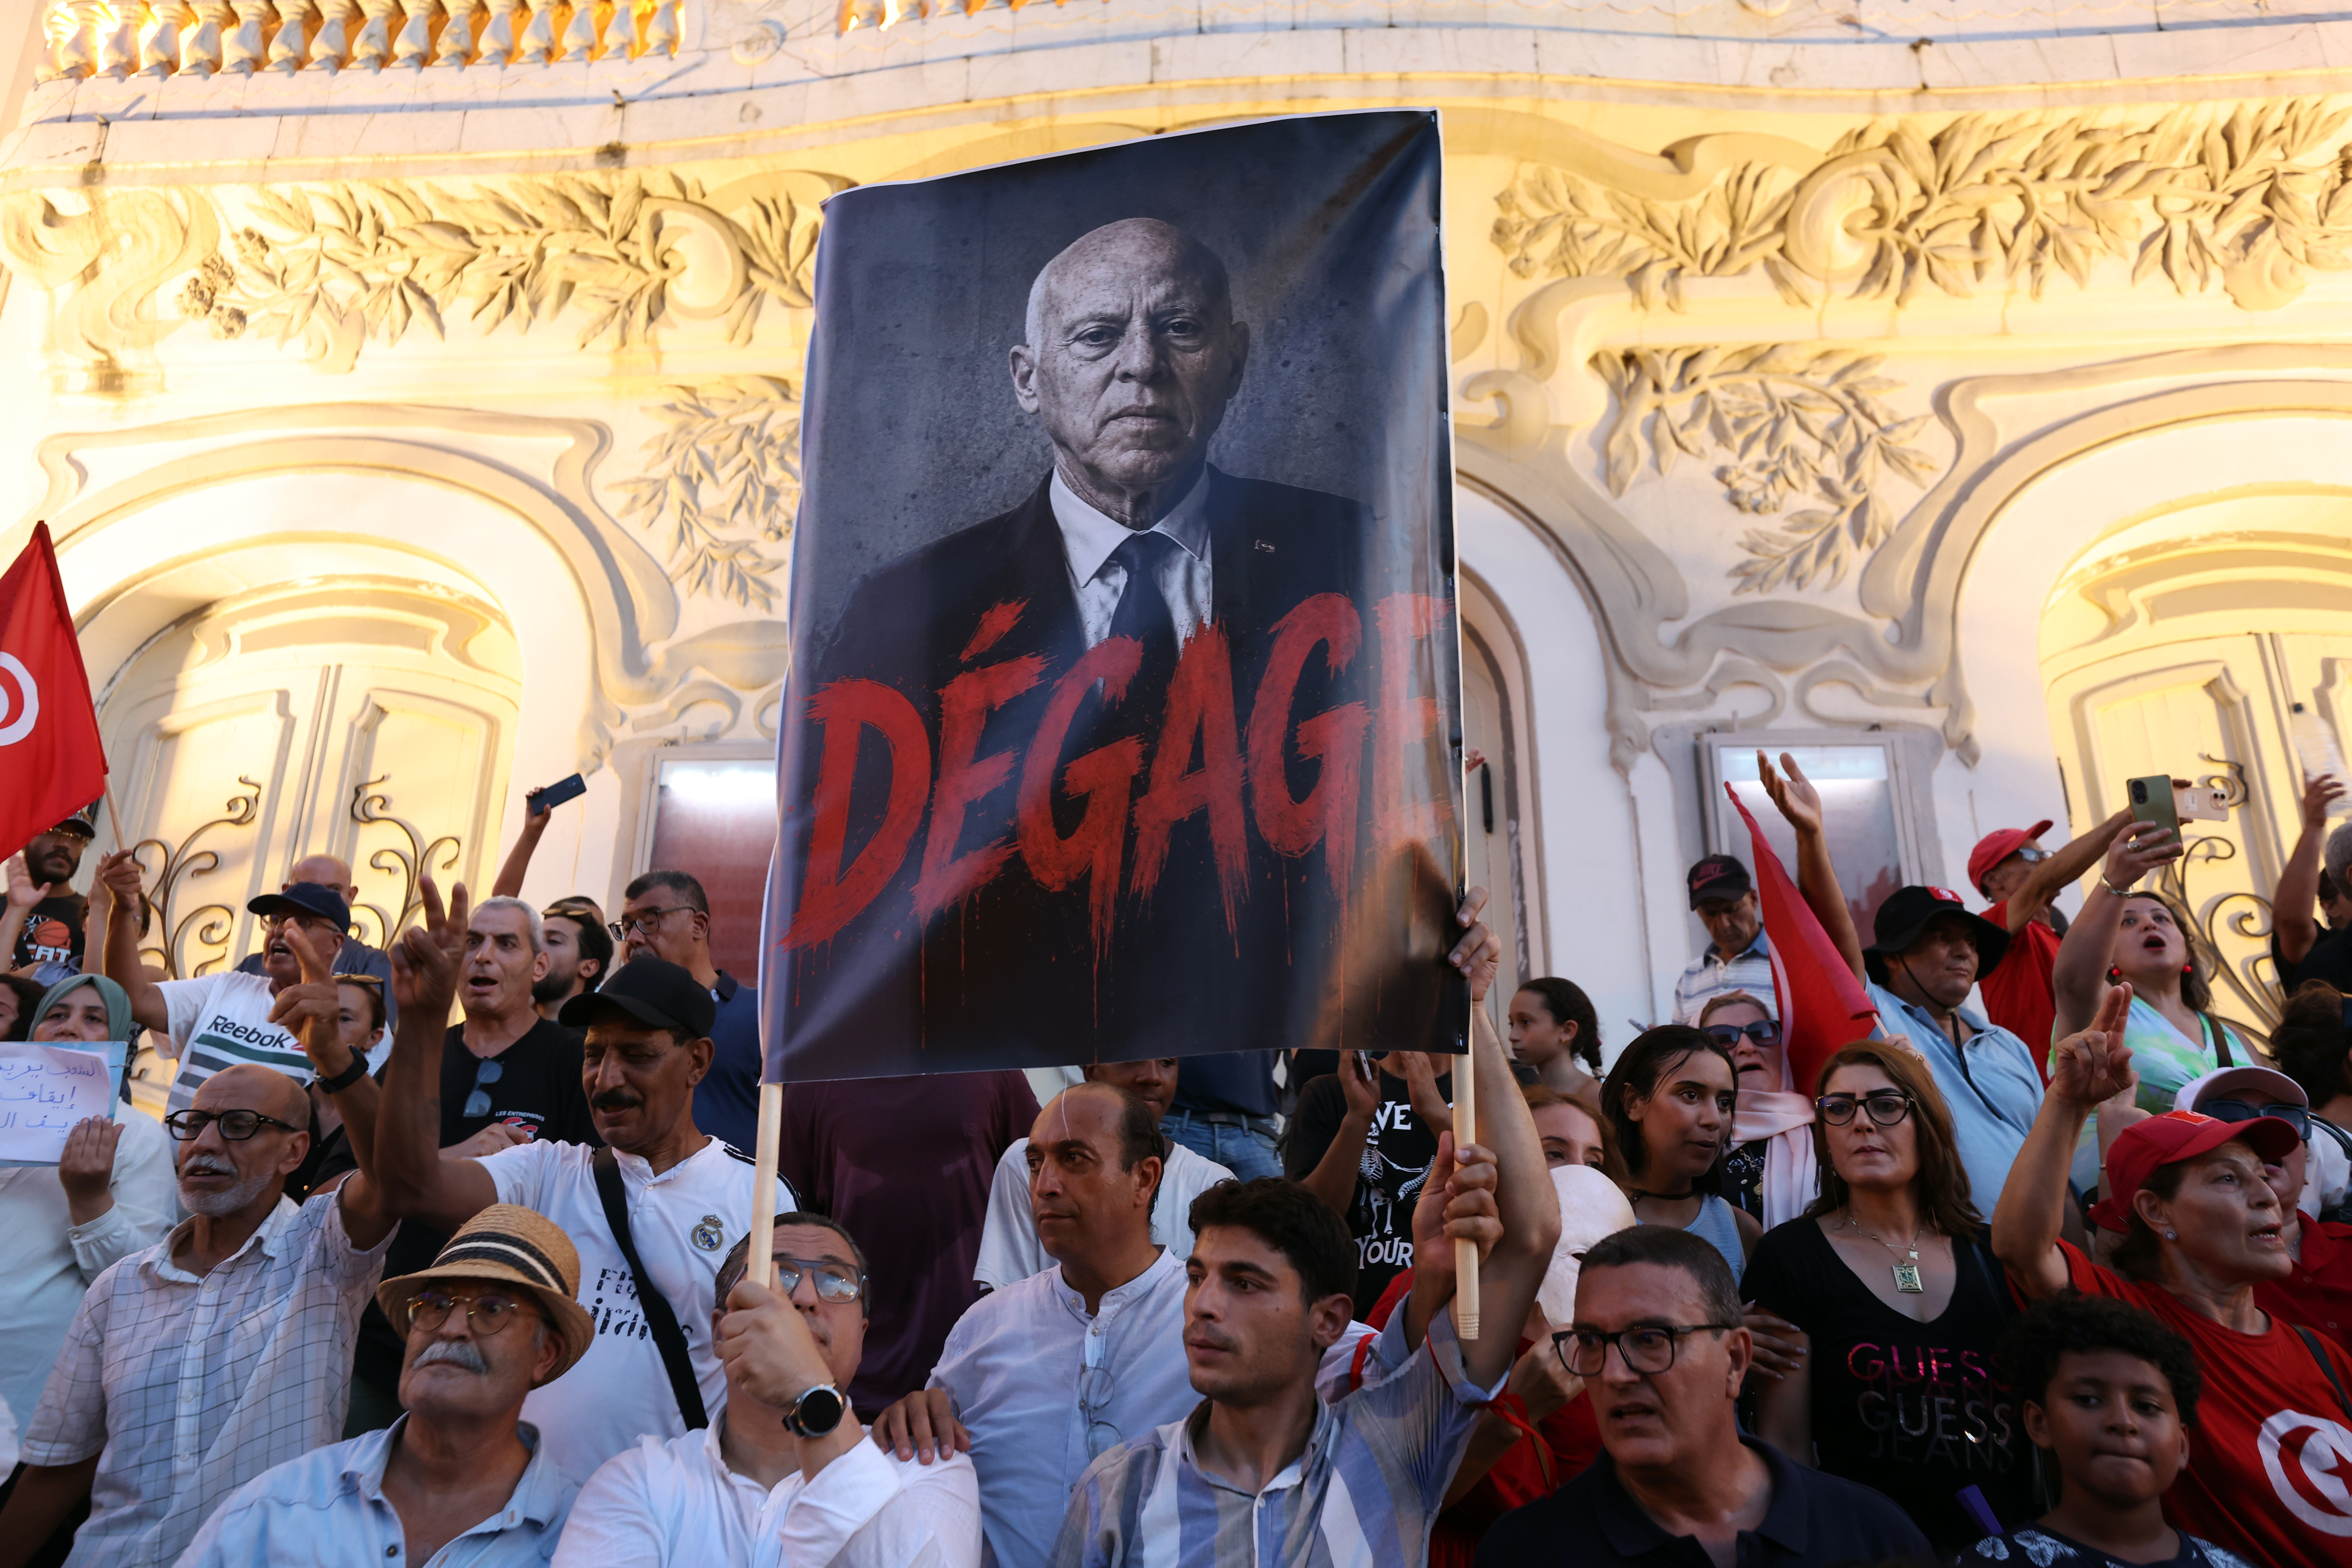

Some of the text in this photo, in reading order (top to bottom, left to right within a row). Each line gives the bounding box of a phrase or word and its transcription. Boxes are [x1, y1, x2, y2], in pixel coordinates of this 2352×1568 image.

[776, 591, 1454, 960] DÉGAGE
[1697, 863, 1724, 877] NIKE
[207, 1014, 291, 1049] Reebok
[0, 1060, 102, 1081] الشعب يري
[0, 1083, 76, 1109] إيقاف
[507, 1110, 545, 1122] ENTREPRISES
[1354, 1234, 1414, 1270] YOUR
[1847, 1342, 2013, 1392] GUESS
[1857, 1390, 2014, 1446] GUESS
[1869, 1418, 2015, 1475] JEANS
